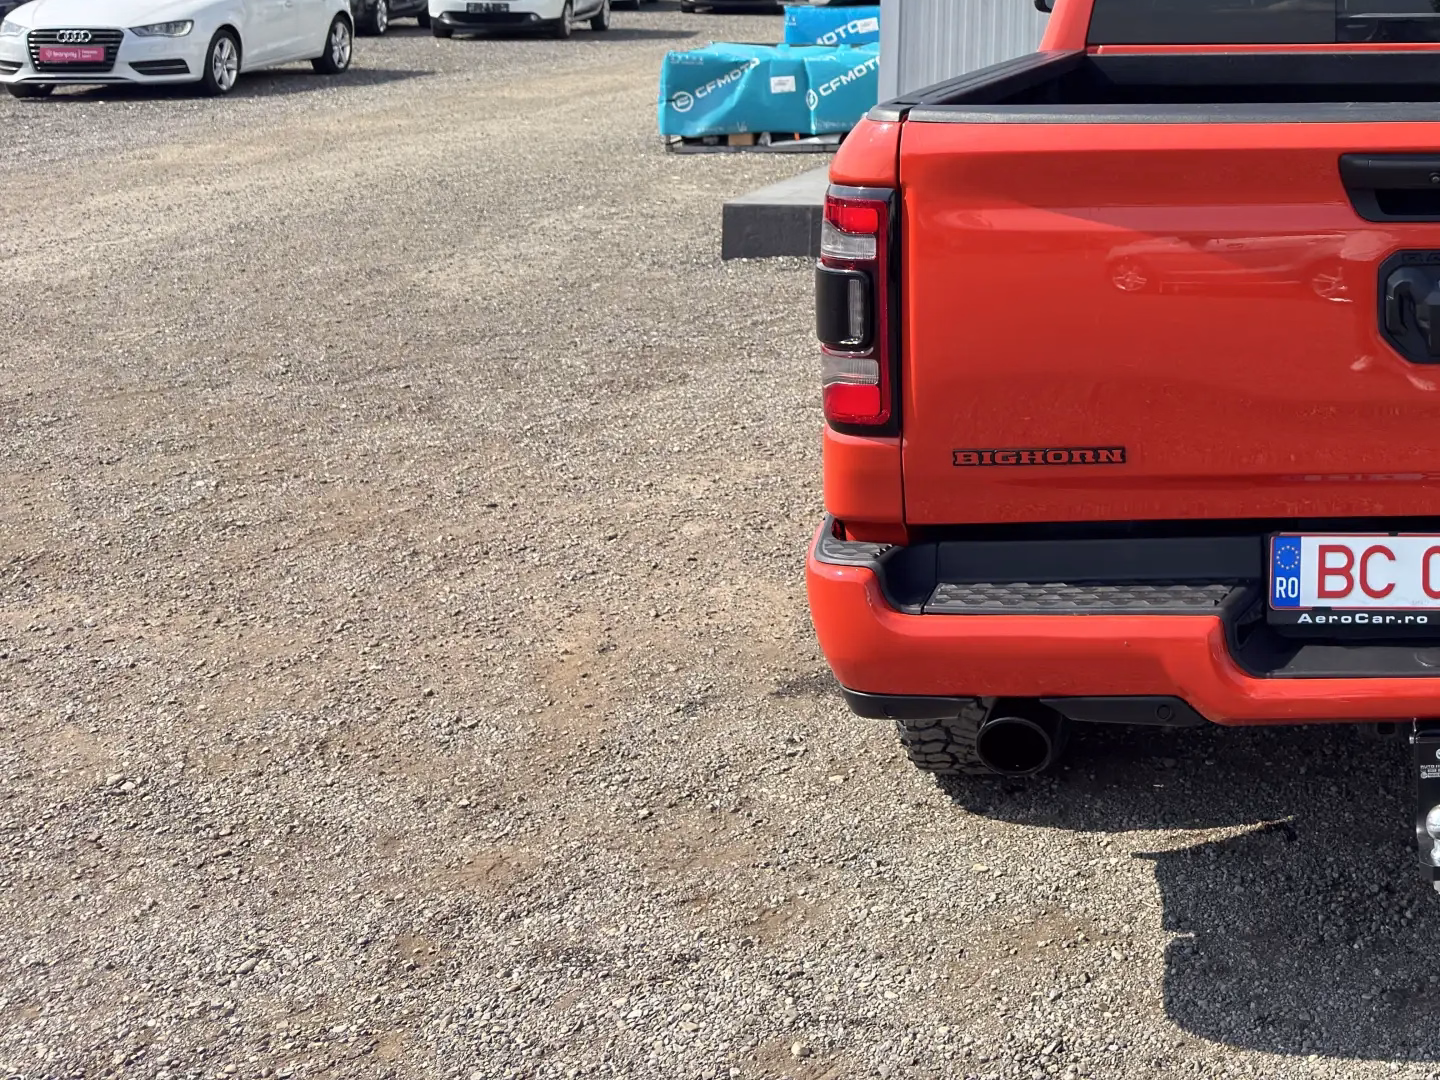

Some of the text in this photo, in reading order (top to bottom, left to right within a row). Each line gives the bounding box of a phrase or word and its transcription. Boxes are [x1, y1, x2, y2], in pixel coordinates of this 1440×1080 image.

[953, 447, 1126, 466] BIGHORN
[1317, 544, 1396, 599] BC
[1275, 576, 1299, 599] RO
[1297, 613, 1428, 624] AeroCar.ro
